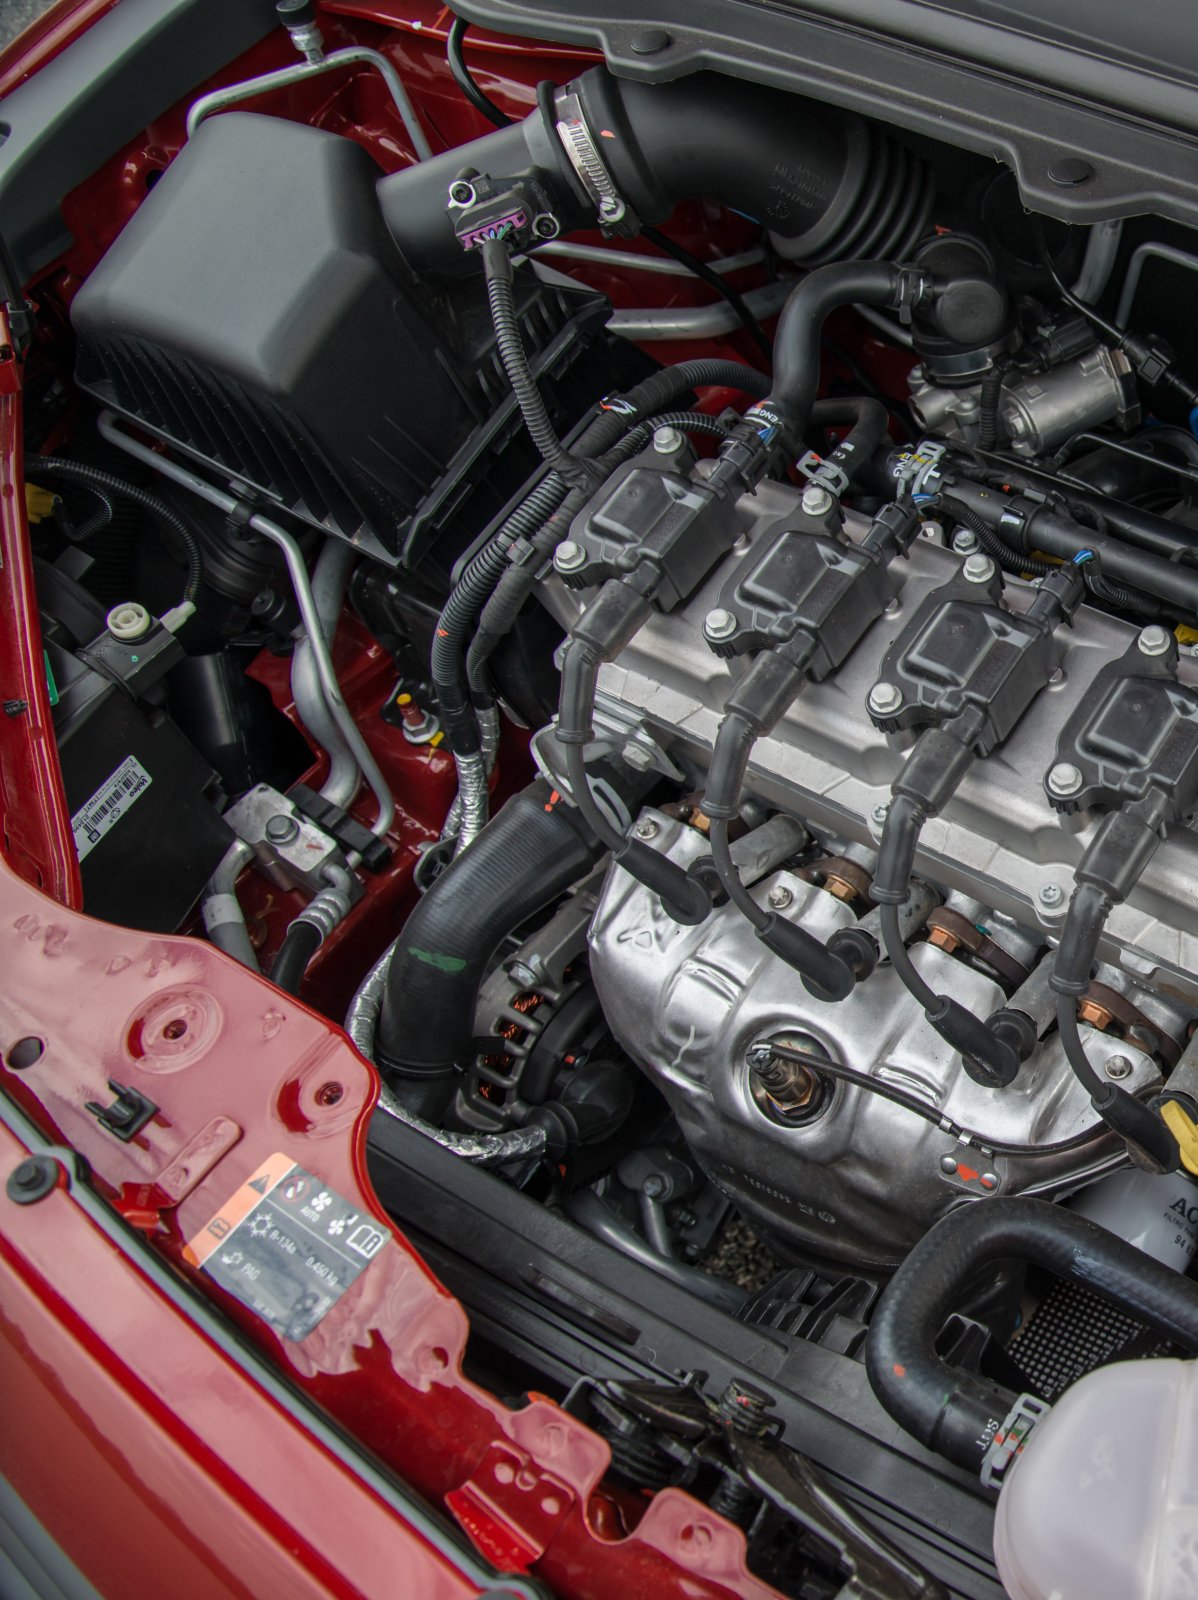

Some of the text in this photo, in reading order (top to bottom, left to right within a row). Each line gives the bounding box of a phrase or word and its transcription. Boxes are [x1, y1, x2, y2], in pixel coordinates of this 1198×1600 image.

[128, 776, 148, 797] Valeo
[300, 1206, 320, 1223] AUTO
[1162, 1212, 1185, 1229] FILTRO
[268, 1230, 339, 1286] R-134a 0.450 kg
[241, 1262, 260, 1281] PAG
